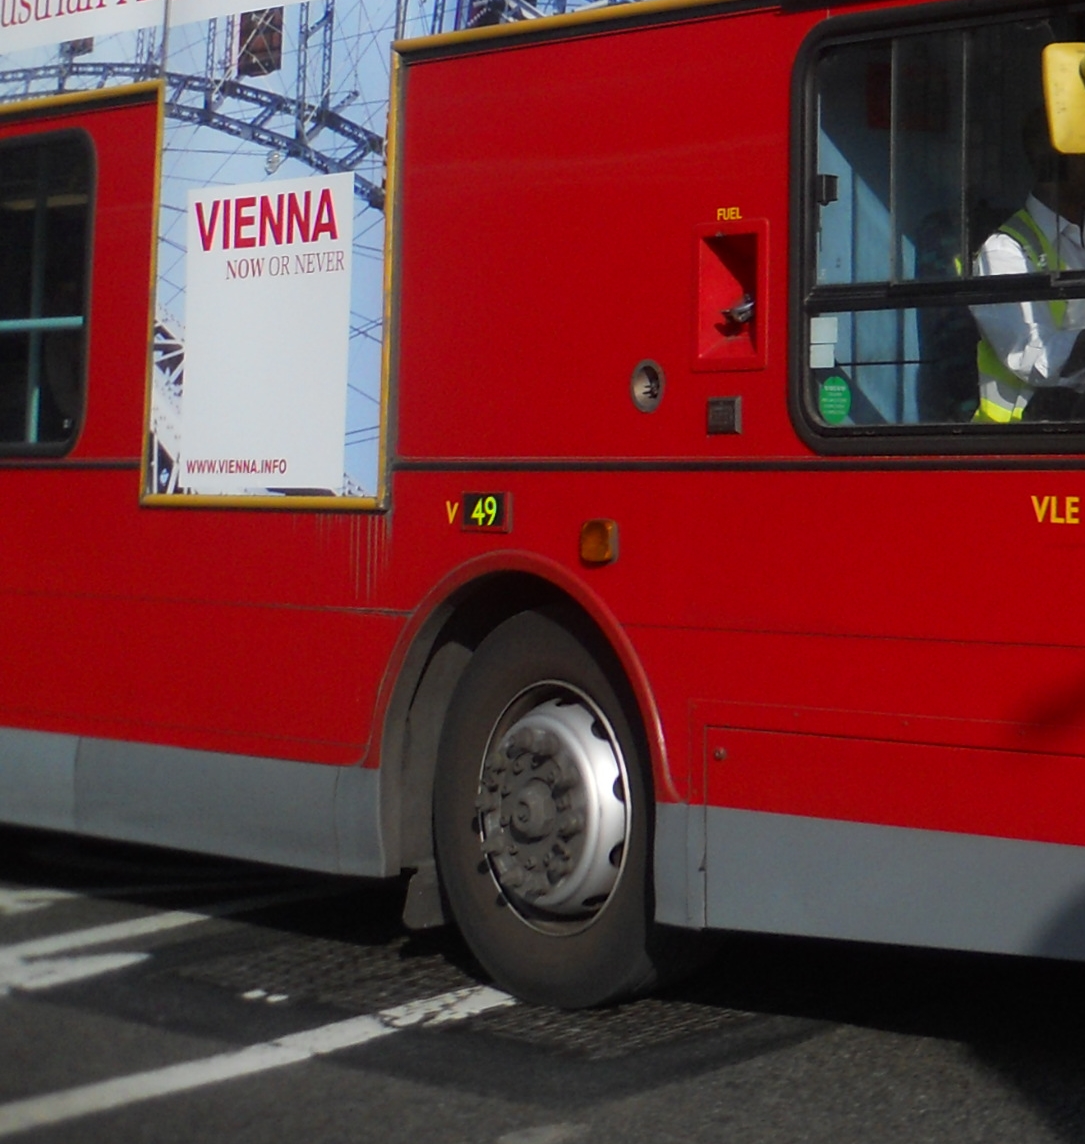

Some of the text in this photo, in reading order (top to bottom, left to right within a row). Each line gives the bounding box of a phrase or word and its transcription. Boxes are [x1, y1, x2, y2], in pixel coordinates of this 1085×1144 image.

[195, 188, 338, 252] VIENNA
[717, 207, 743, 221] FUEL
[226, 250, 345, 280] NOW OR NEVER
[186, 459, 288, 474] WWW.VIENNA.INFO
[446, 496, 497, 526] V 49
[1031, 495, 1080, 524] VLE
